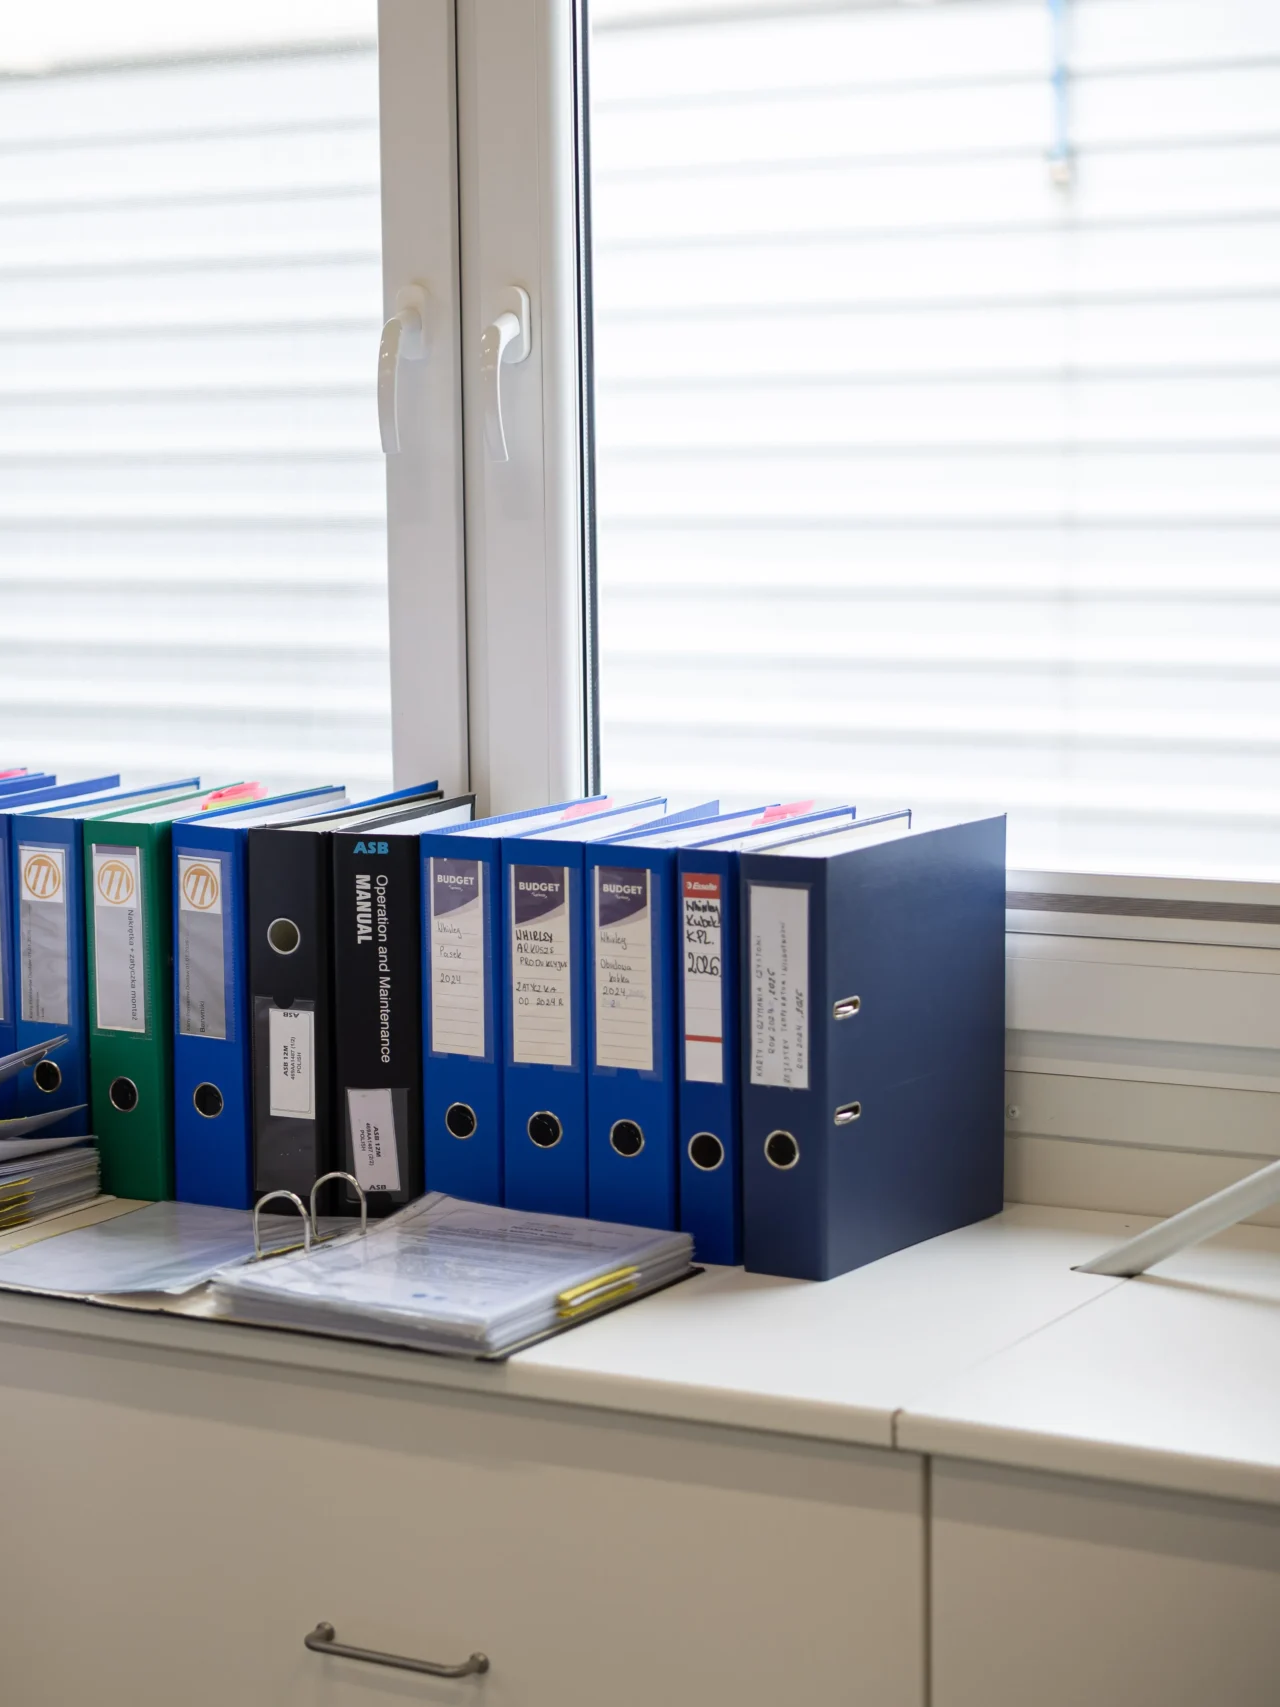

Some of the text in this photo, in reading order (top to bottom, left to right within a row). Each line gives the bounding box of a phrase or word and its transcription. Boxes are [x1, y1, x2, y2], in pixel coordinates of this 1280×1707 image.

[353, 841, 389, 855] ASB
[437, 874, 474, 886] BUDGET
[518, 881, 560, 893] BUDGET
[693, 881, 718, 891] Esselte
[602, 883, 642, 895] BUDGET
[355, 874, 373, 945] MANUAL
[686, 900, 721, 924] Whirley
[127, 909, 135, 946] Nakrętka
[686, 914, 720, 928] Kubek
[515, 929, 553, 943] WHIRLEY
[600, 931, 628, 950] Whirley
[439, 945, 462, 959] Pasek
[128, 954, 136, 989] zatyczka
[374, 874, 391, 1064] Operation and Maintenance
[600, 958, 632, 971] Obudowa
[440, 972, 461, 985] 2024
[515, 981, 557, 993] ZATYCZKA
[518, 997, 530, 1006] OD
[756, 986, 764, 1044] UTRZYMANIA
[767, 1035, 775, 1054] ROK
